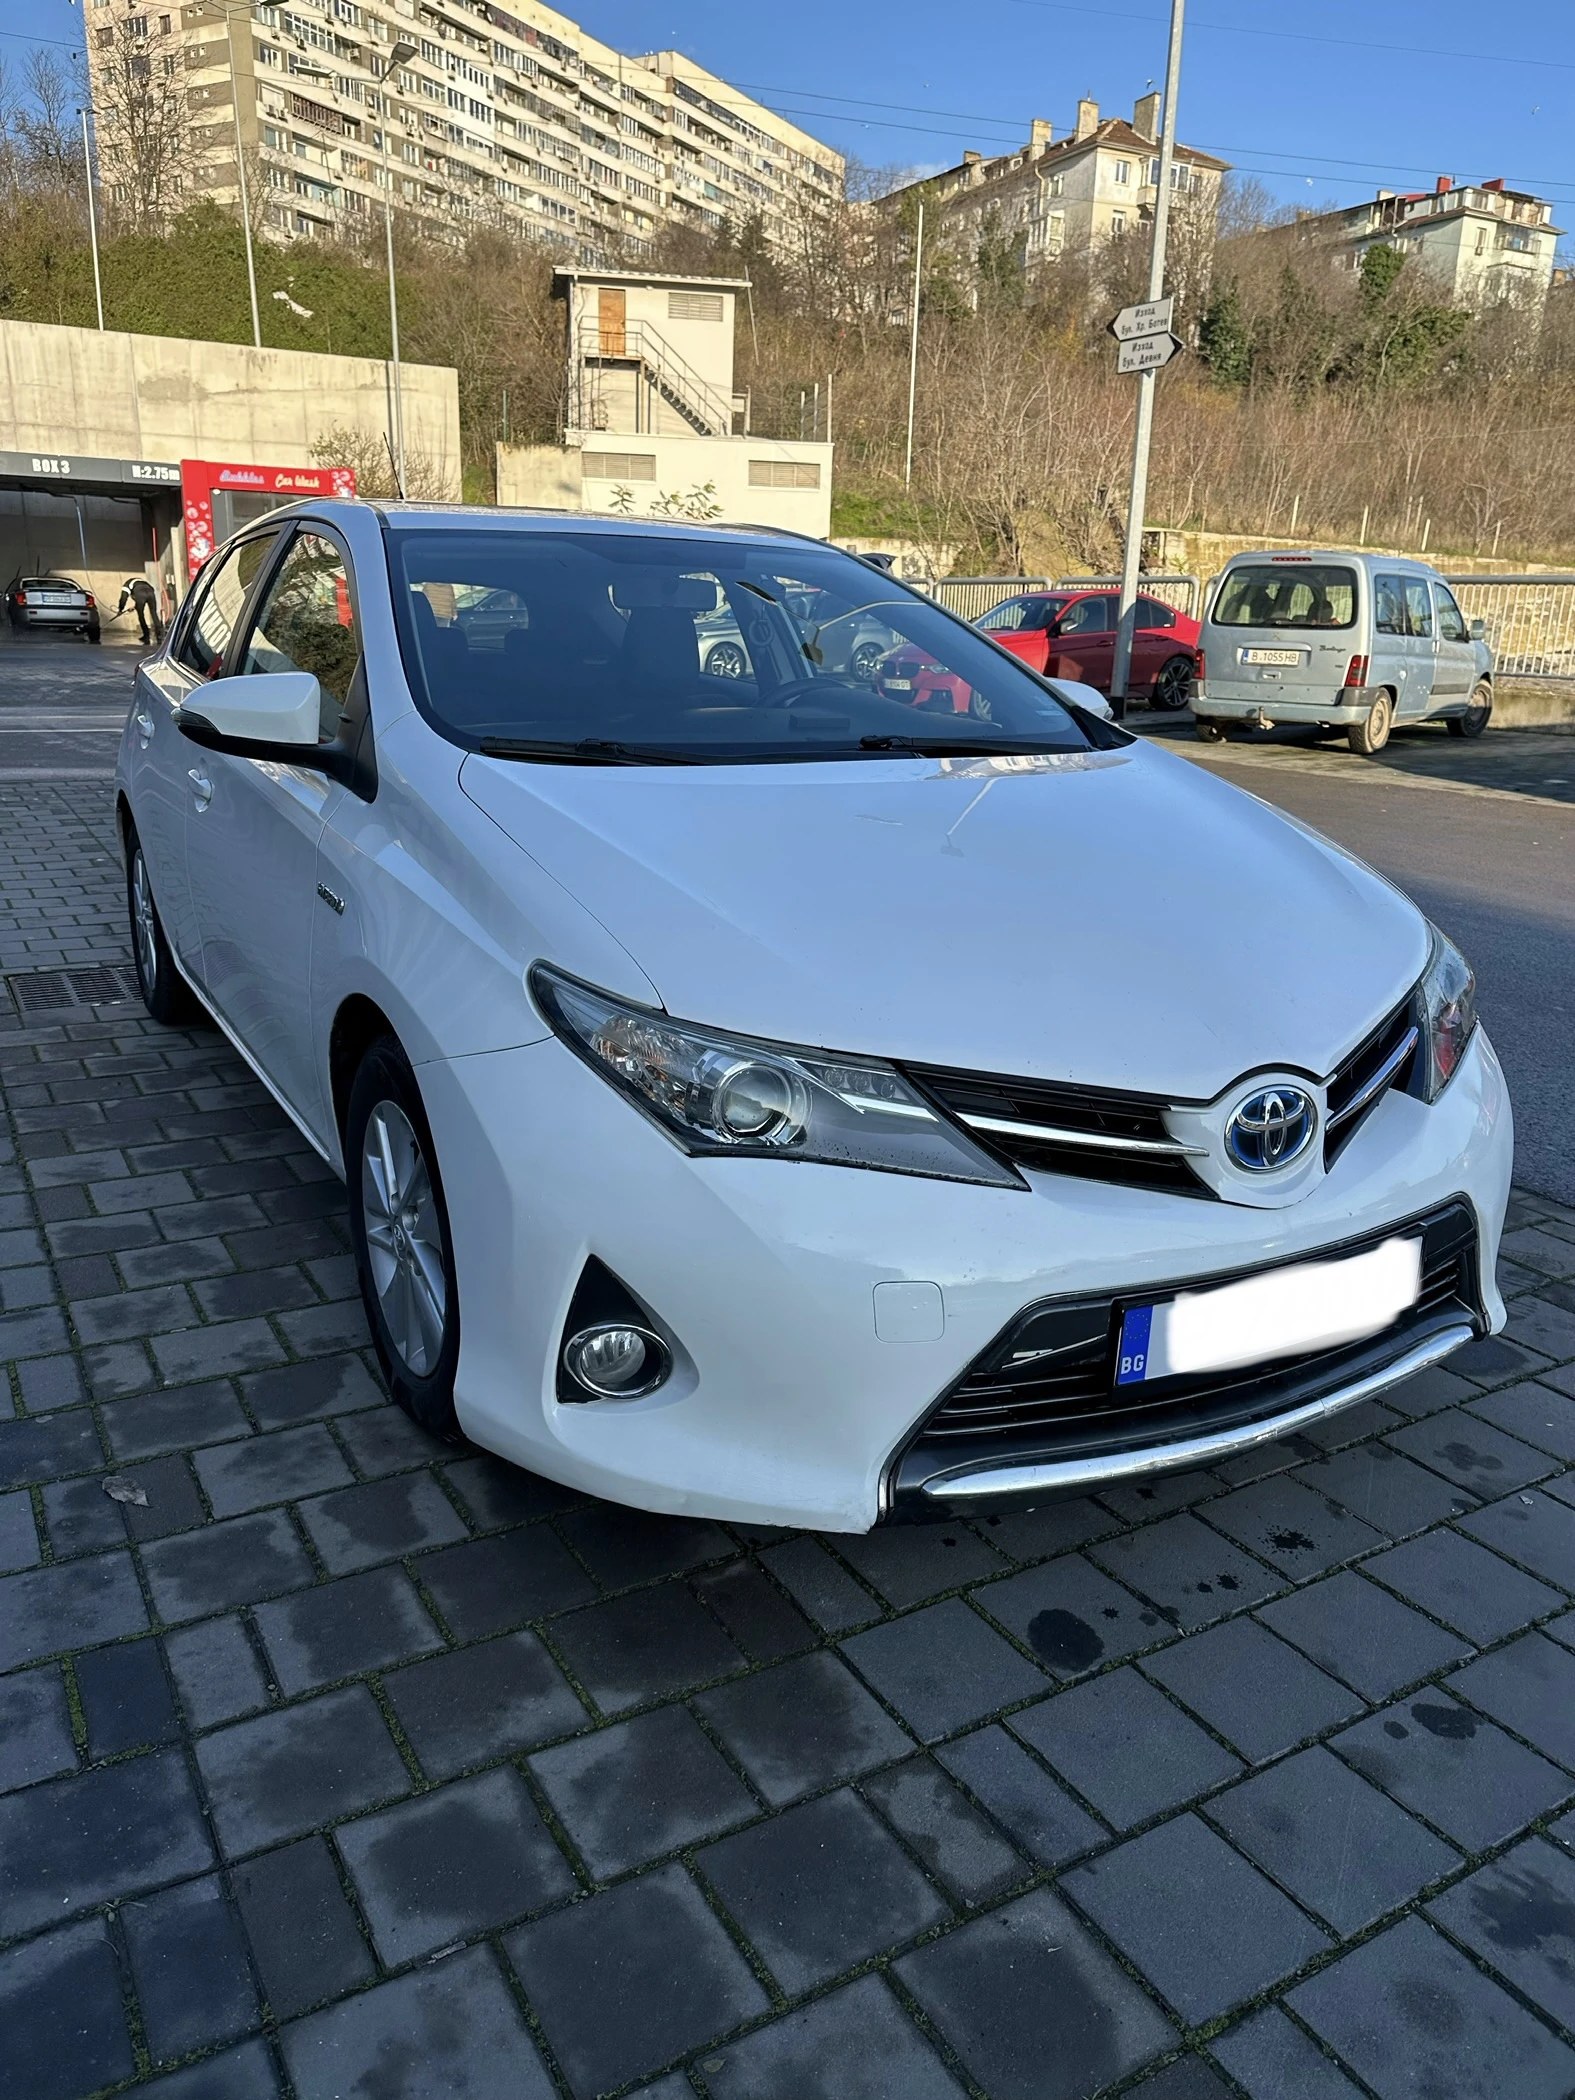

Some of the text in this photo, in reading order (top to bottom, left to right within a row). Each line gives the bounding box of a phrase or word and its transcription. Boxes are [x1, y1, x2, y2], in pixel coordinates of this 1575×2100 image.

[1135, 308, 1155, 318] Изход
[1148, 318, 1168, 329] Ботев
[1132, 342, 1153, 352] Изход
[1138, 353, 1161, 365] Девня
[32, 458, 70, 474] BOX 3
[132, 465, 180, 480] H:2.75m
[275, 473, 293, 488] Car
[294, 474, 320, 489] Wash
[1120, 1354, 1145, 1375] BG
